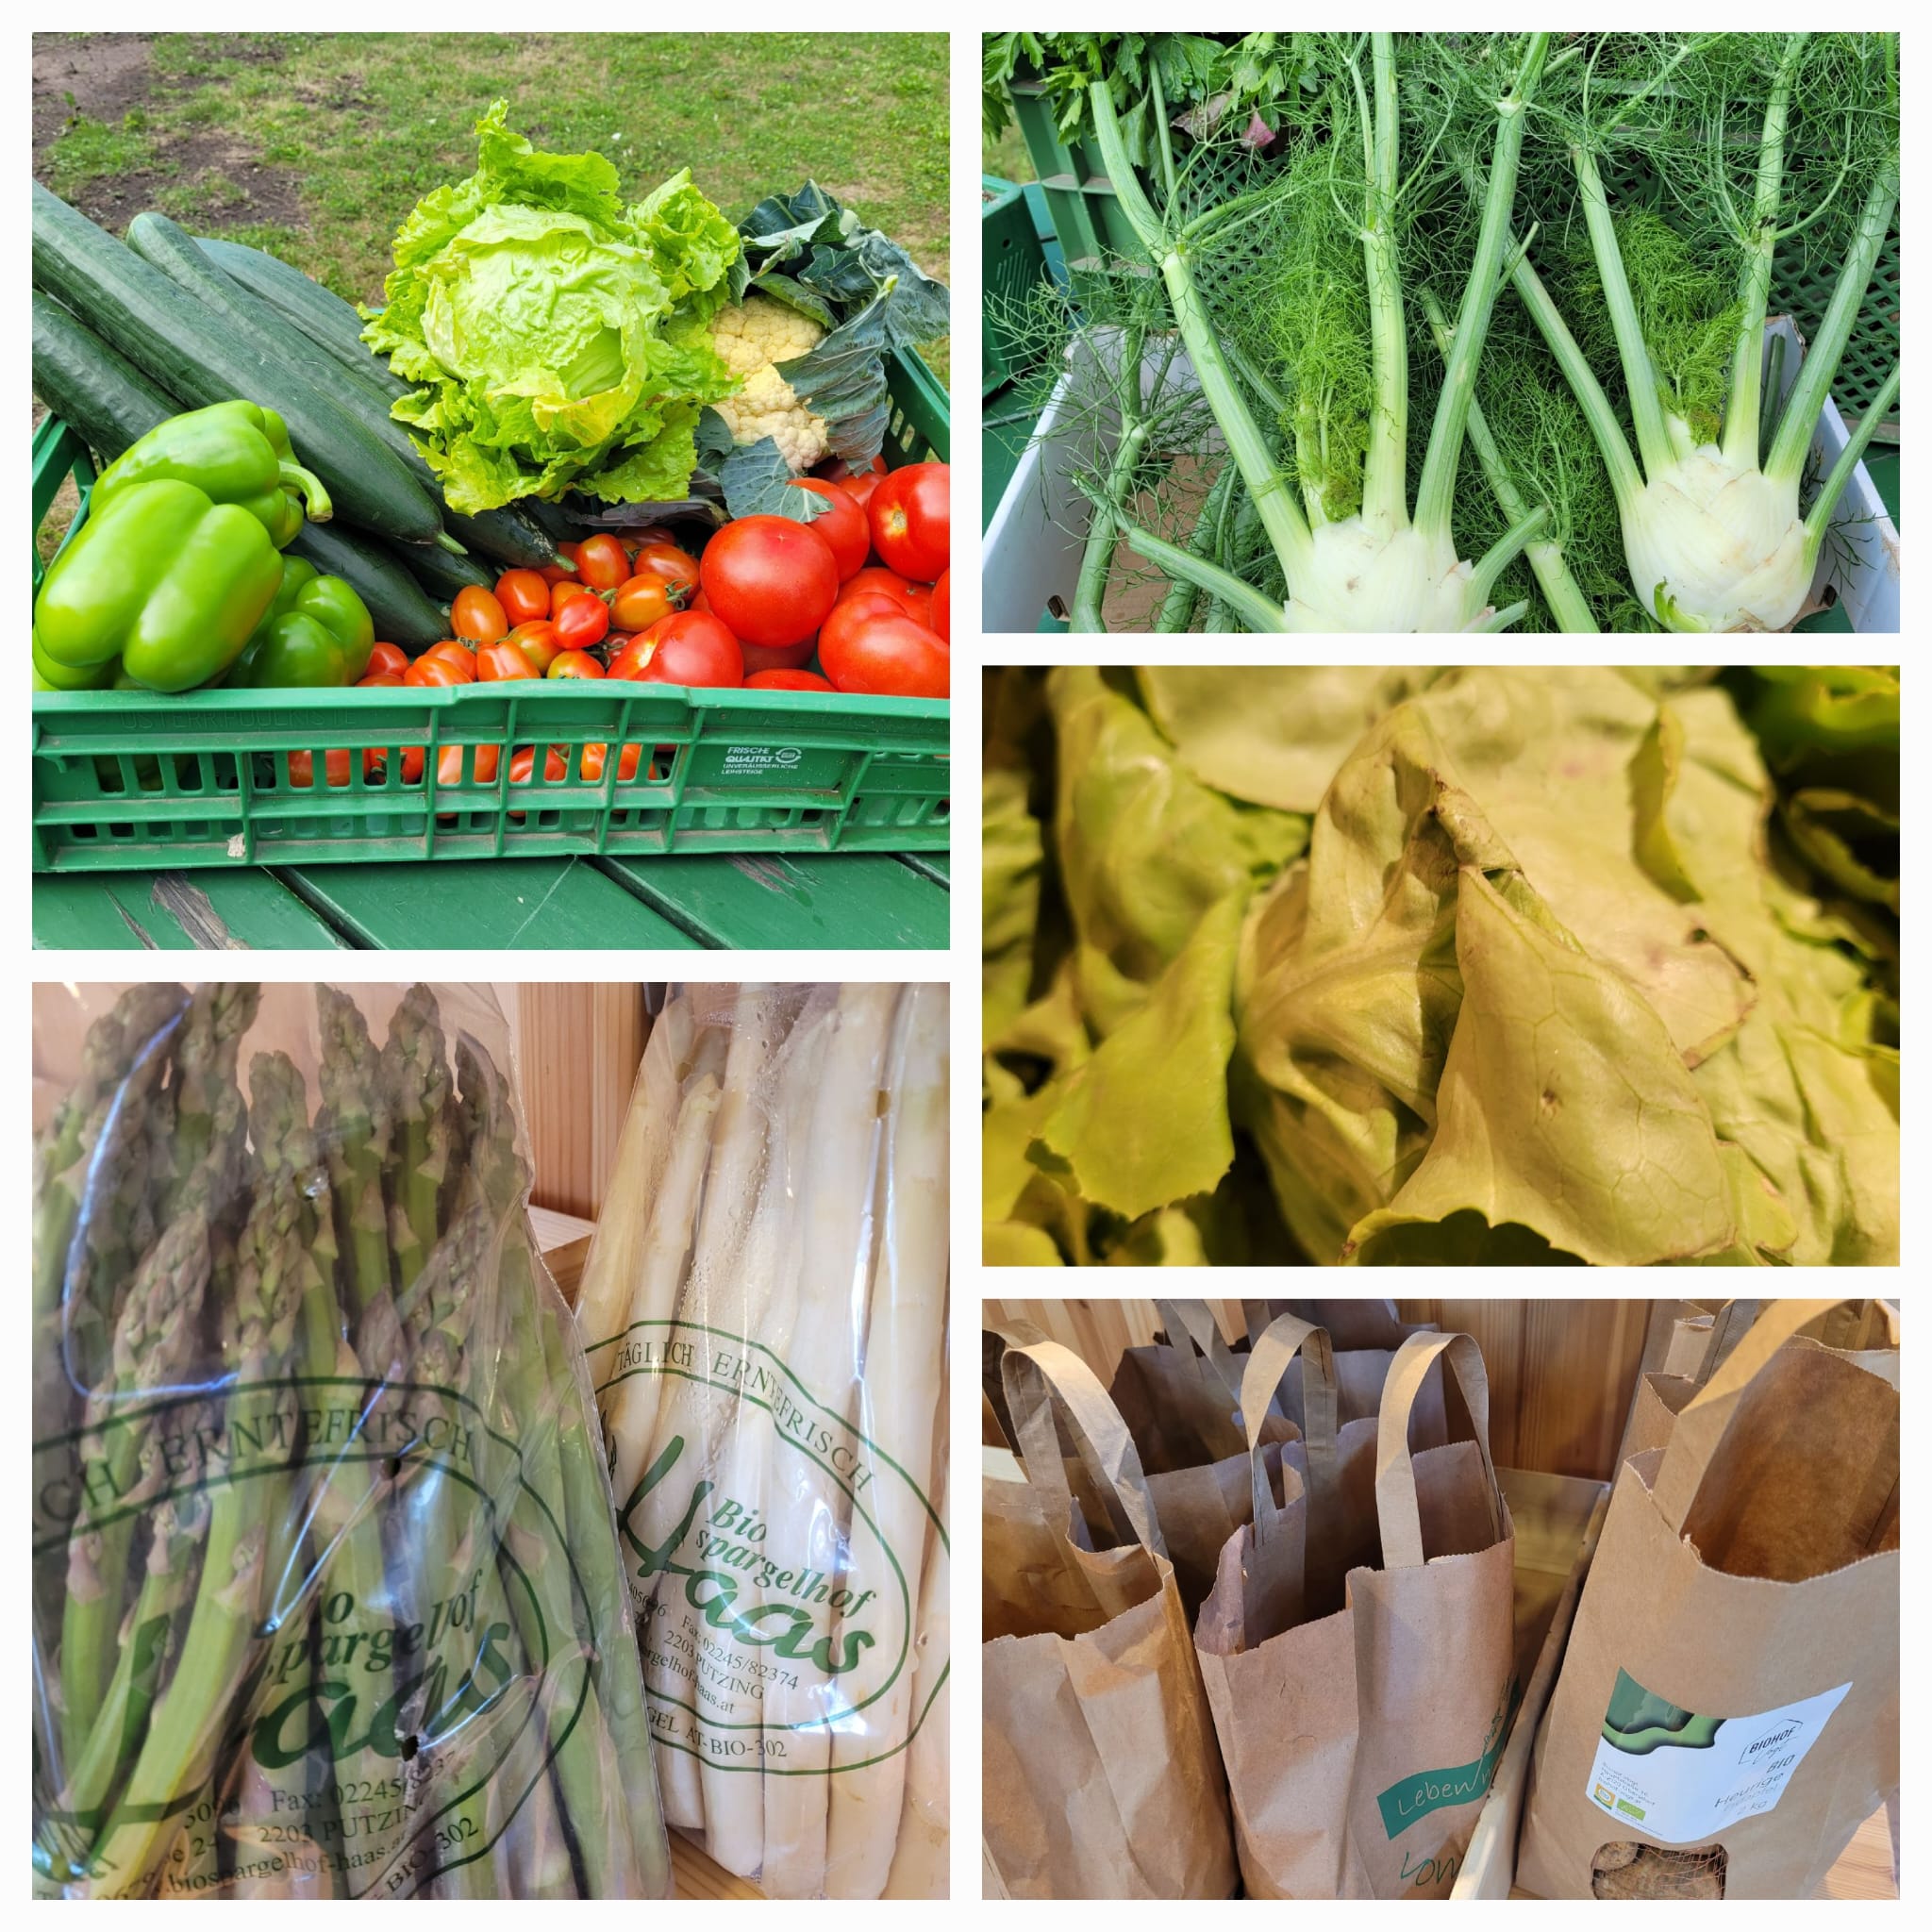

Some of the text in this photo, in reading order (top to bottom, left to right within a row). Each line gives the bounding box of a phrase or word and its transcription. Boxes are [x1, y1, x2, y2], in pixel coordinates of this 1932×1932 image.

[157, 1409, 474, 1474] ERNTEFRISCH
[618, 1341, 876, 1492] TÄGLICH ERNTEFRISCH
[706, 1497, 768, 1541] Bio
[695, 1529, 877, 1619] spargelhof
[663, 1629, 695, 1658] 2203
[681, 1614, 703, 1644] Fax:
[703, 1637, 800, 1690] 02245/82374
[1749, 1725, 1797, 1755] BIOHOF
[1766, 1754, 1796, 1774] BIO
